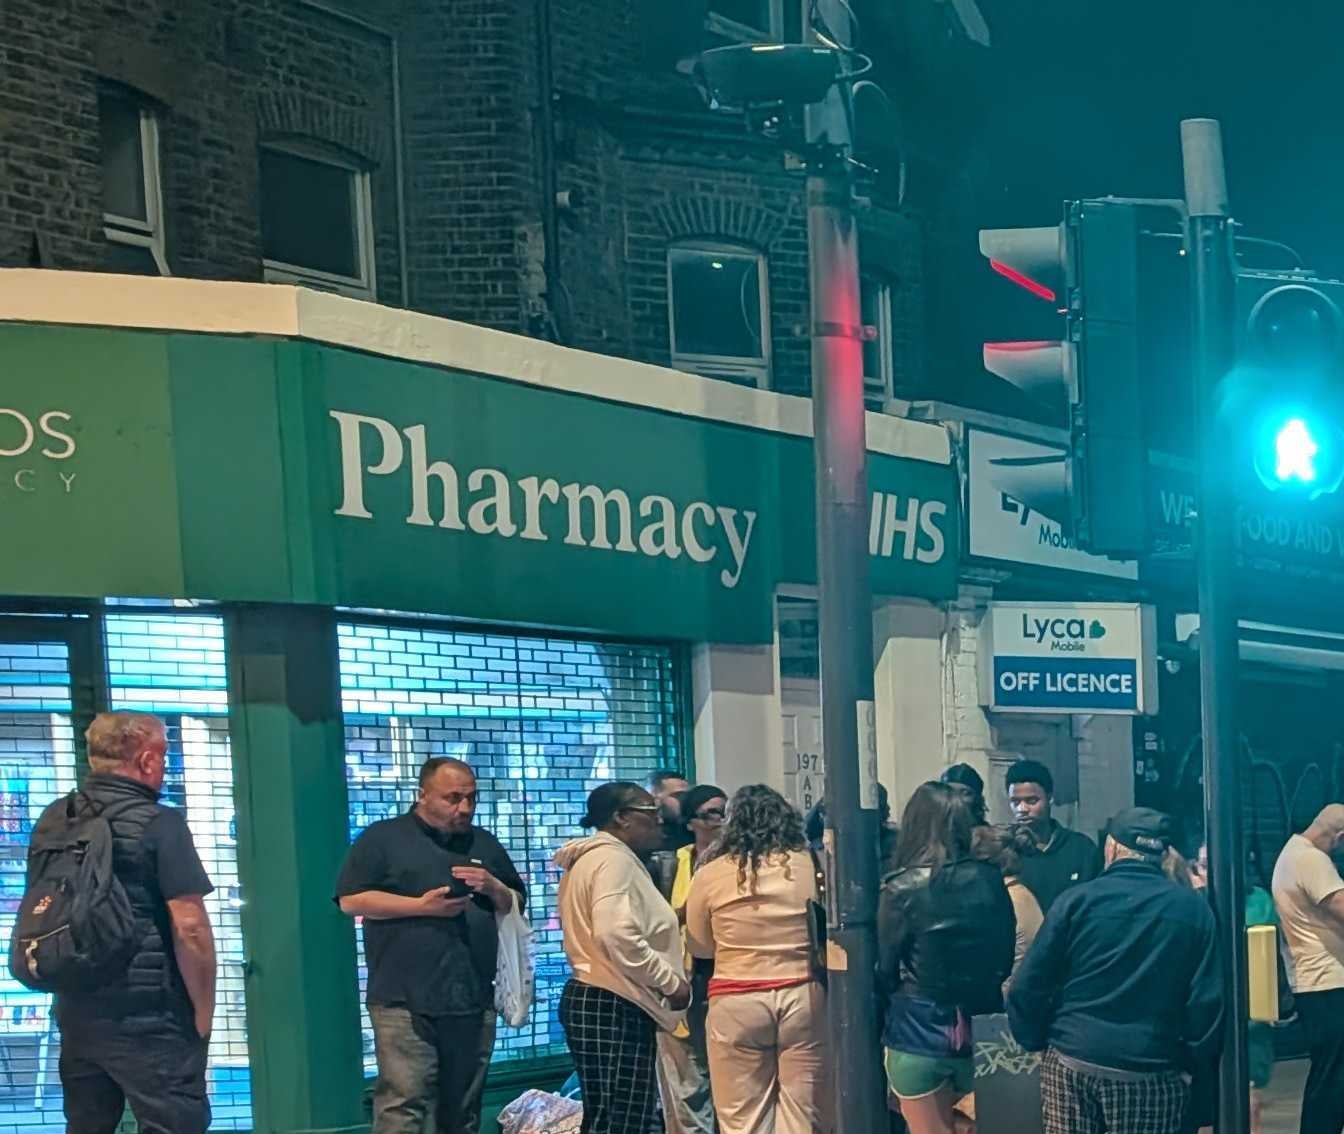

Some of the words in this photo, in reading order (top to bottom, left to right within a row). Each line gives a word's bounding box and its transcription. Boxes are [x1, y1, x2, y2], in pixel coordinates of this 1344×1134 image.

[329, 410, 757, 588] Pharmacy
[1022, 613, 1085, 643] Lyca
[1050, 640, 1086, 652] Mobile
[1000, 671, 1040, 693] OFF
[1046, 673, 1133, 694] LICENCE
[797, 753, 818, 771] 197
[803, 776, 812, 791] A
[804, 794, 812, 810] B
